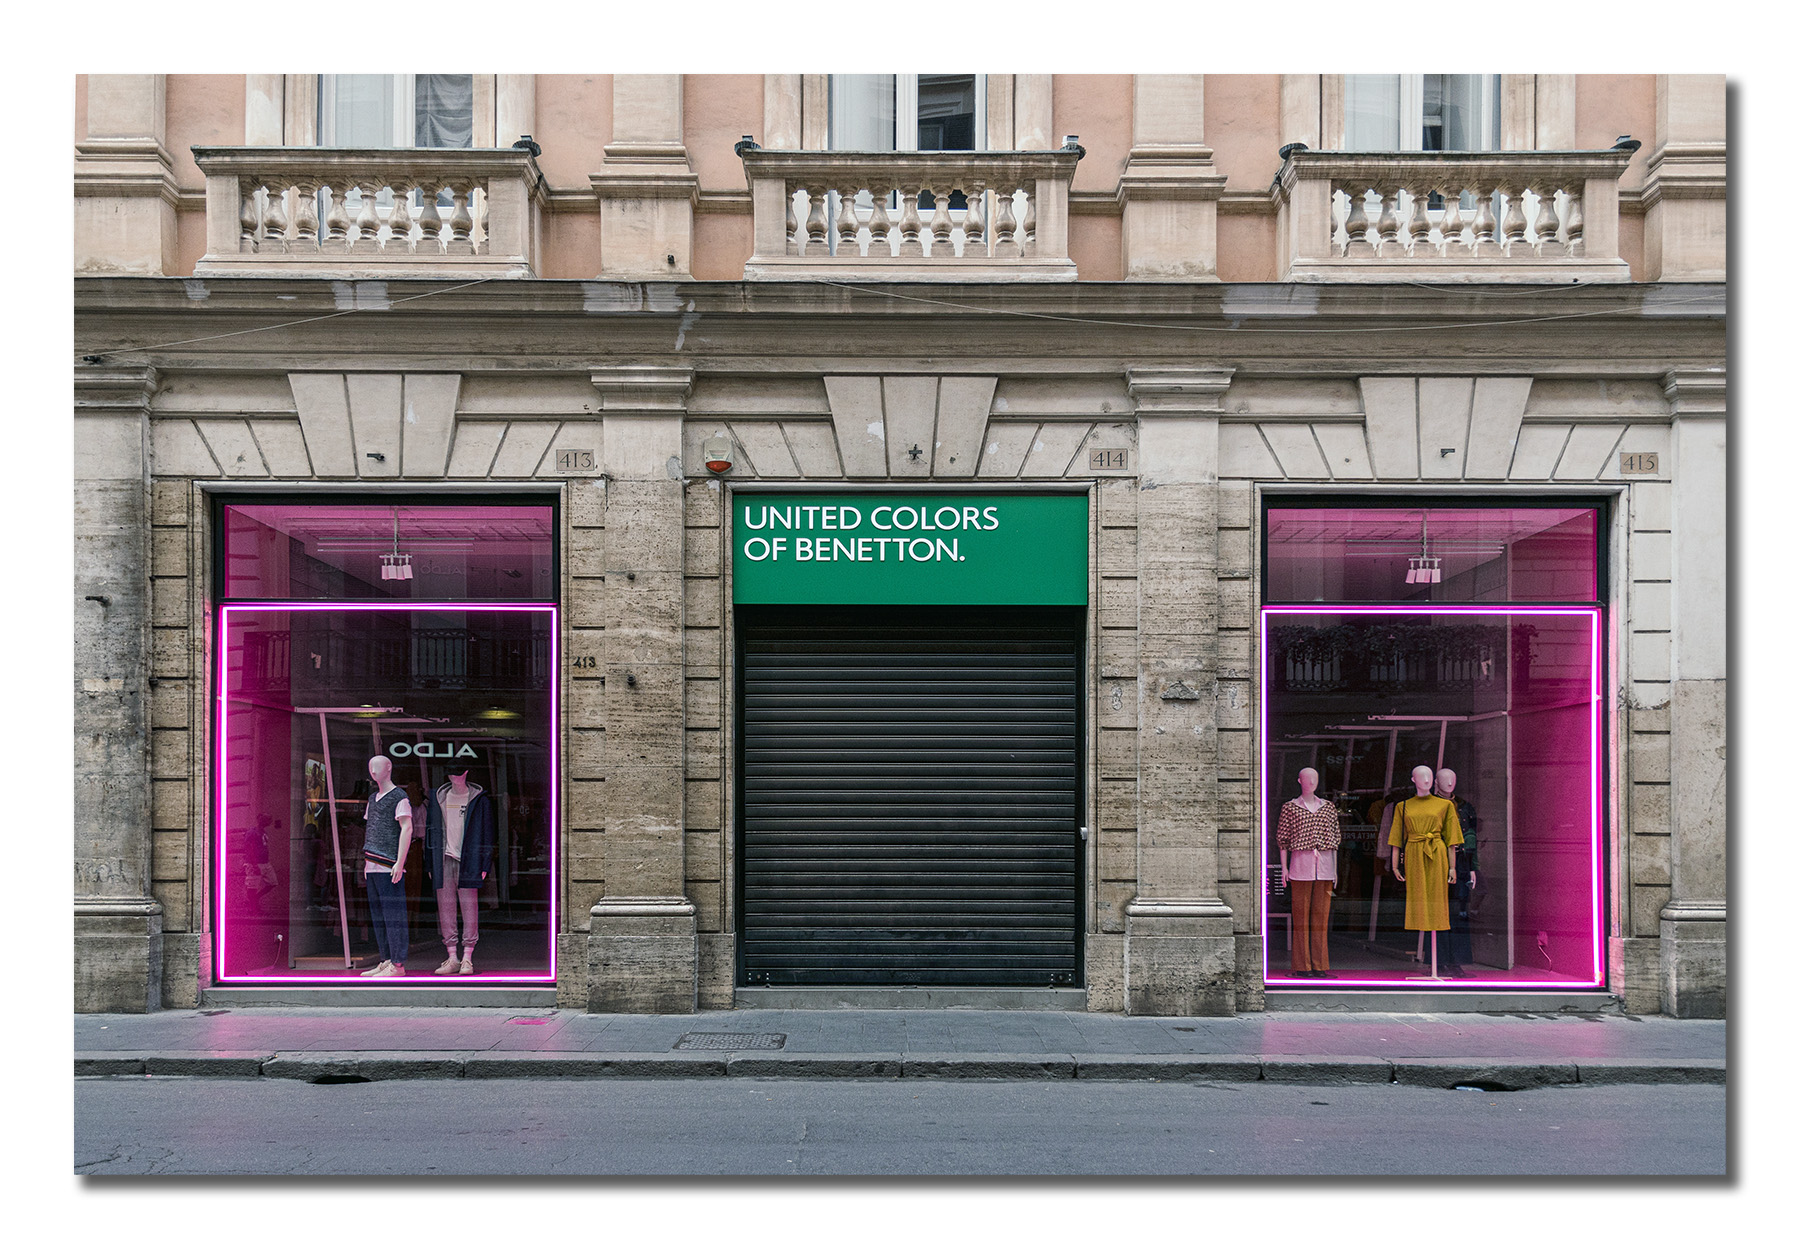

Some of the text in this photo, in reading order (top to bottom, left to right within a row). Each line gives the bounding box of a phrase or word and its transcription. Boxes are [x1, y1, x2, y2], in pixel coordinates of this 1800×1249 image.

[560, 452, 592, 468] 413
[1093, 451, 1125, 466] 414
[1623, 455, 1655, 470] 415
[745, 506, 999, 530] UNITED COLORS
[744, 537, 966, 562] OF BENETTON.
[573, 656, 596, 668] 413
